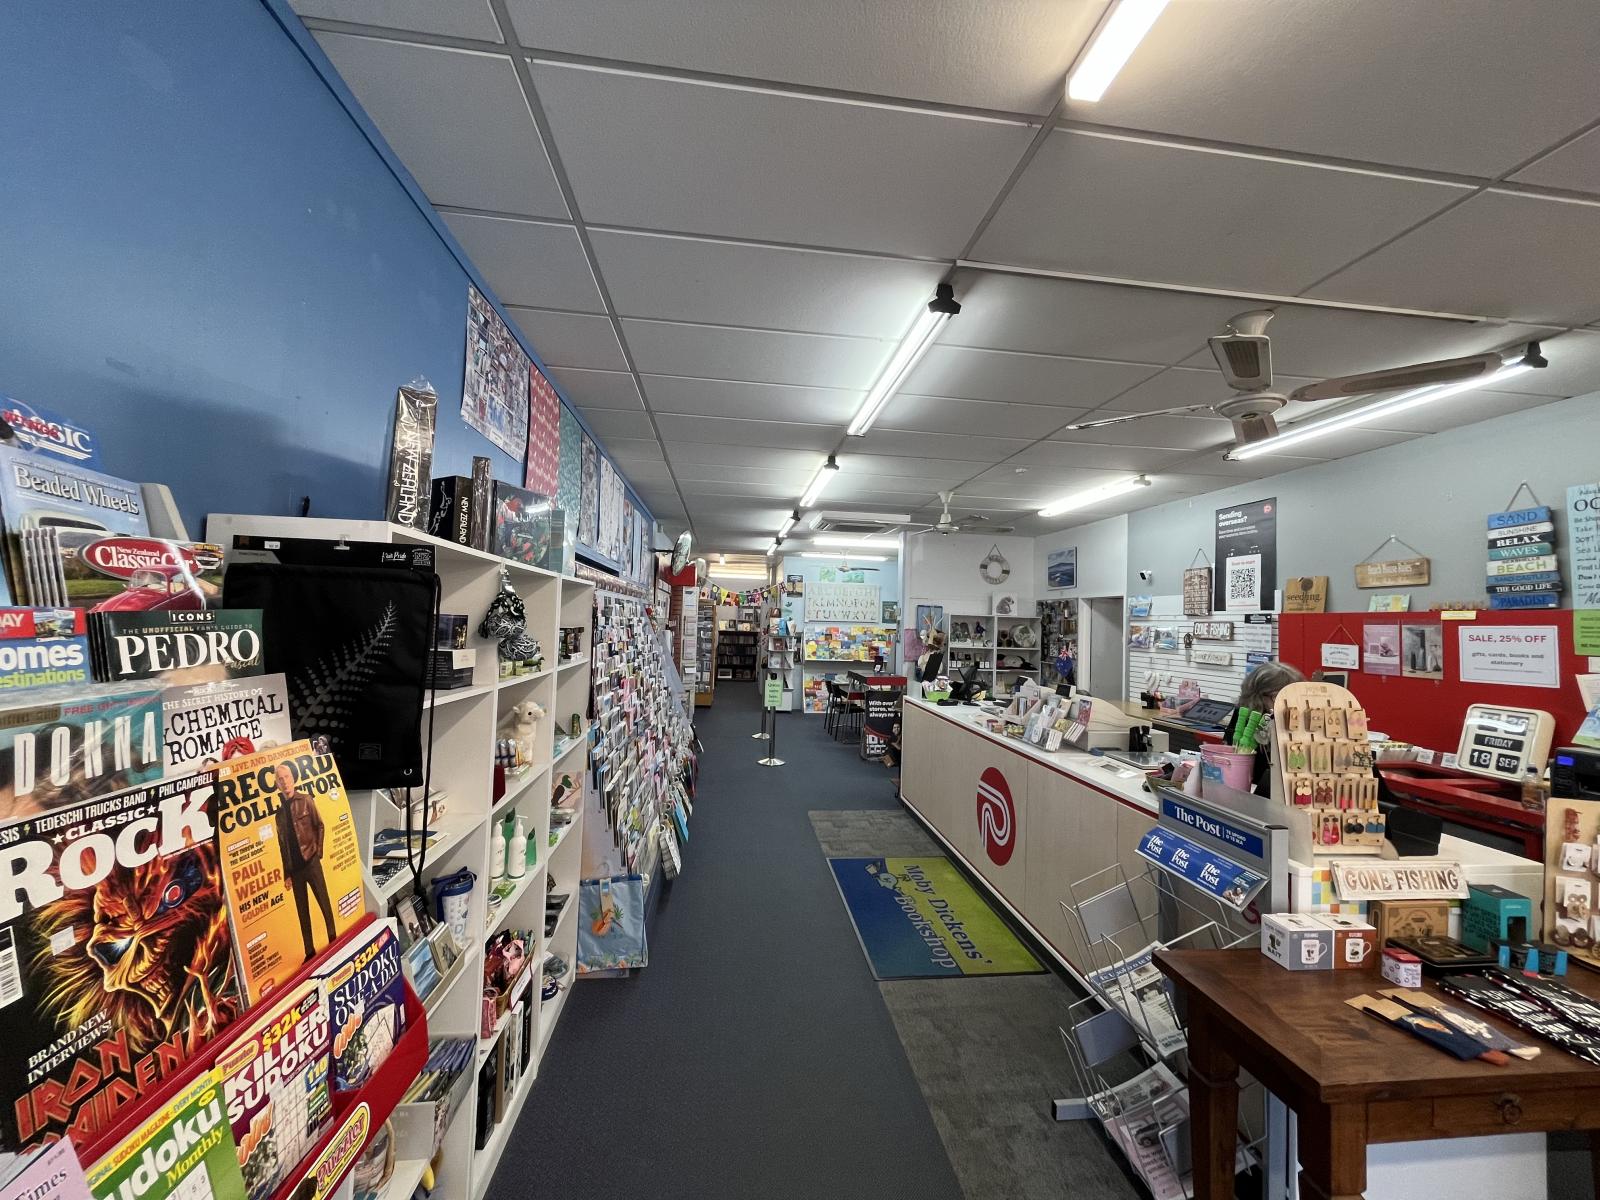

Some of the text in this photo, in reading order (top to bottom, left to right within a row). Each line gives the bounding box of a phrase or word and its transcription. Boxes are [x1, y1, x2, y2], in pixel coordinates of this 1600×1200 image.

[13, 465, 140, 515] Beaded Wheels
[397, 460, 418, 524] ZEALAND
[459, 496, 472, 544] NEW ZEALAND
[1218, 510, 1243, 521] Sending
[1218, 516, 1248, 527] overseas?
[1497, 511, 1538, 526] SAND
[1496, 535, 1541, 547] RELAX
[1498, 525, 1538, 536] SUNSHINE
[95, 546, 161, 569] Classic
[117, 546, 160, 557] New Zealand
[1499, 546, 1539, 557] WAVES
[1496, 561, 1547, 574] BEACH
[1511, 584, 1534, 592] GOOD
[1496, 594, 1548, 607] PARADISE
[0, 613, 24, 628] AY
[172, 612, 213, 622] ICONS
[1194, 622, 1230, 636] GONE FISHING
[142, 625, 194, 634] UNOFFICIAL
[1468, 634, 1548, 643] SALE, 25% OFF
[114, 629, 260, 675] PEDRO
[182, 695, 213, 707] SECRET
[214, 690, 249, 702] HISTORY
[251, 687, 264, 696] OF
[170, 693, 283, 737] CHEMICAL
[164, 717, 263, 766] ROMANCE
[1484, 736, 1513, 748] FRIDAY
[14, 711, 158, 798] DONNA
[231, 762, 249, 774] LIVE
[249, 756, 267, 769] AND
[1472, 751, 1518, 769] 18 SEP
[217, 754, 335, 812] RECORD
[0, 772, 214, 846] SIS TEDESCHI TRUCKS BAND PHIL CAMPBELL
[219, 772, 342, 834] COLLTOR
[65, 807, 146, 840] CLASSIC
[1174, 805, 1221, 837] The Post
[1147, 841, 1163, 855] Post
[1150, 835, 1164, 846] The
[0, 786, 216, 925] ROCK
[1171, 855, 1189, 869] Post
[1175, 848, 1190, 860] The
[231, 860, 266, 886] PAUL
[1200, 870, 1220, 886] Post
[1205, 862, 1221, 876] The
[1345, 868, 1459, 892] GONE FISHING
[235, 868, 283, 902] WELLER
[239, 890, 269, 914] HIS NEW
[241, 893, 285, 923] GOLDEN AGE
[903, 865, 993, 965] Moby Dickens'
[894, 895, 957, 969] Bookshop
[334, 940, 399, 1003] SUDOKU
[335, 961, 399, 1026] ONE-A-DAY
[28, 1009, 108, 1069] BRAND NEW
[27, 1020, 112, 1085] INTERVIEWS!
[224, 1005, 329, 1105] KILLER
[227, 1019, 329, 1125] SUDOKU
[15, 1027, 131, 1143] IRON
[112, 1140, 140, 1166] SUDOKU
[140, 1110, 171, 1141] MAGAZINE
[165, 1125, 225, 1189] Monthly
